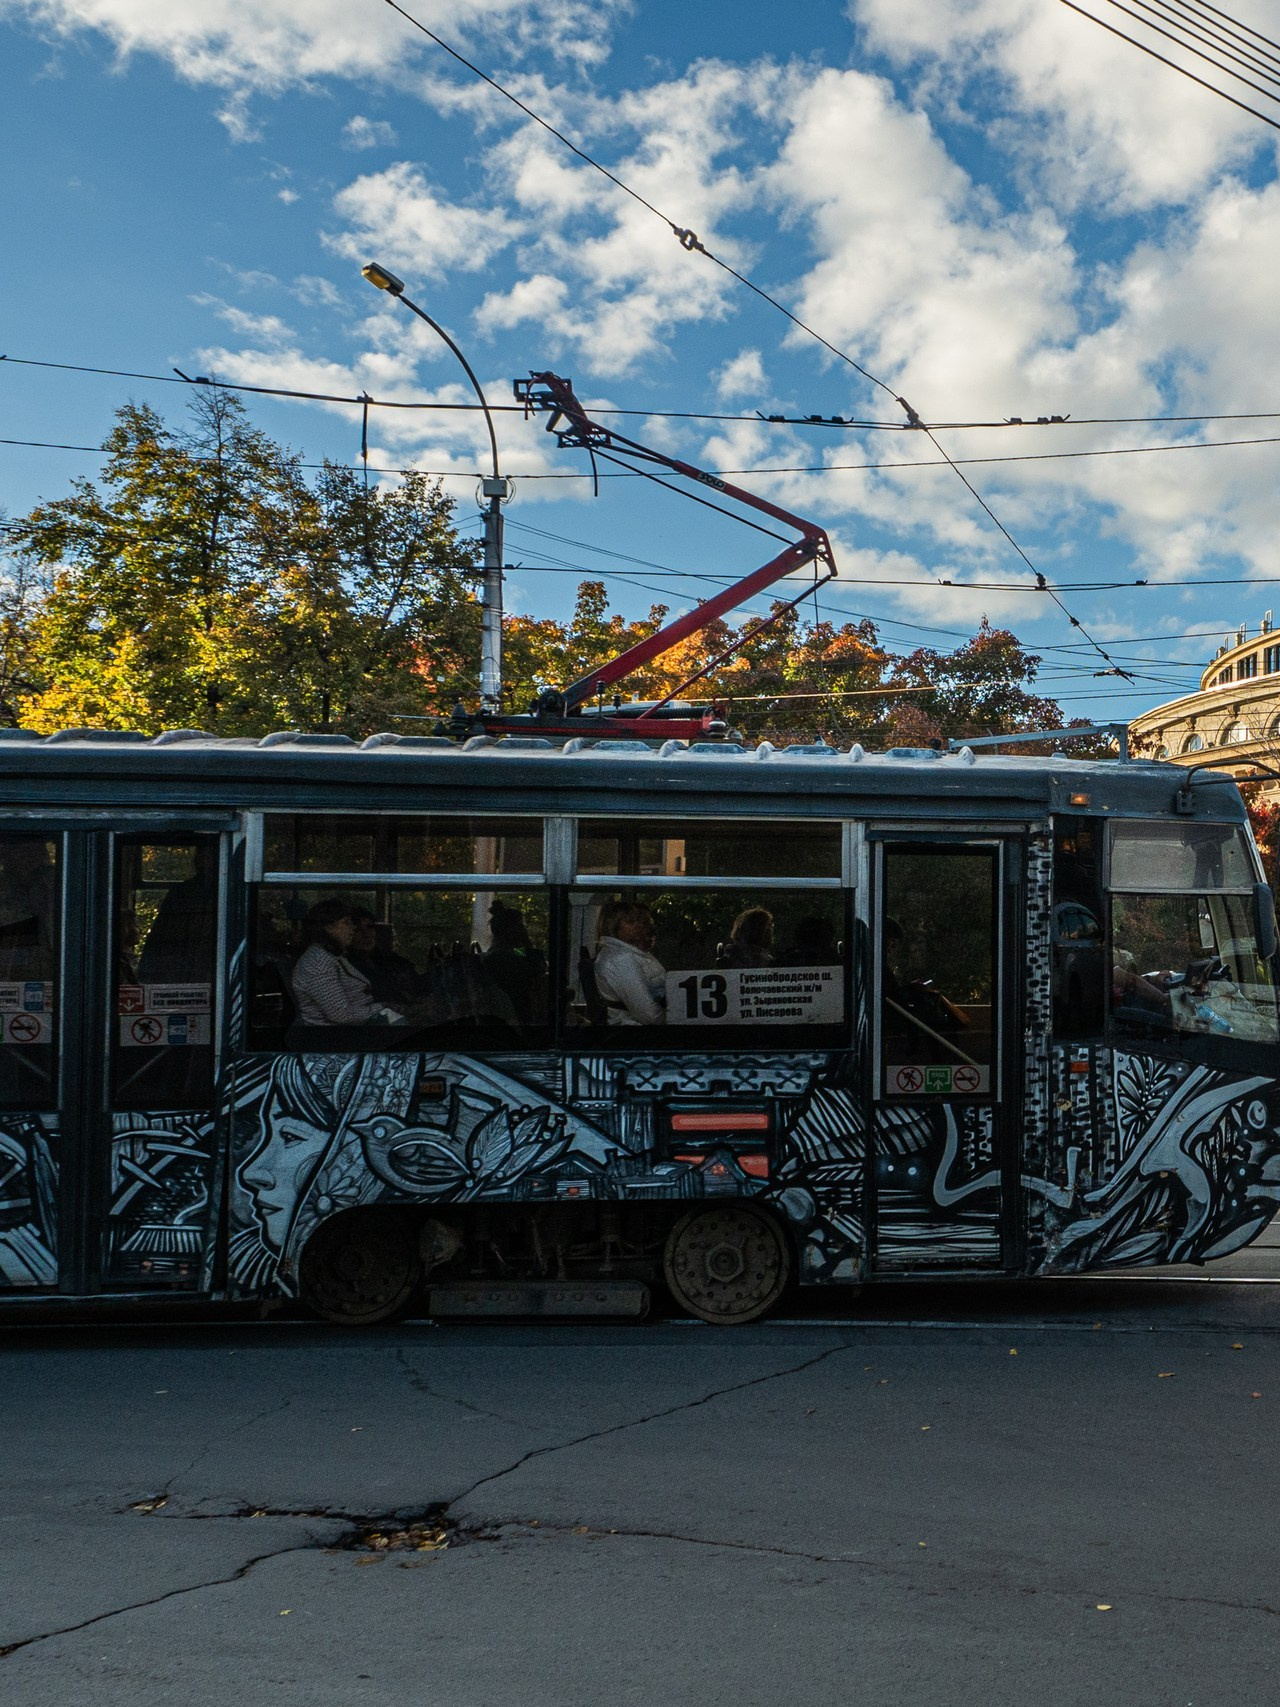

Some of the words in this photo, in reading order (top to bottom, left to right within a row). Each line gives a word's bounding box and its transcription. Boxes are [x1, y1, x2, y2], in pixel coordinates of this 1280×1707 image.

[740, 972, 820, 984] Гусинобродское
[821, 972, 833, 981] ш.
[740, 983, 802, 994] Волочаевский
[803, 983, 822, 992] ж/м
[678, 974, 728, 1019] 13
[740, 998, 752, 1006] ул.
[753, 995, 813, 1005] Зыряновская
[740, 1009, 754, 1018] ул.
[756, 1007, 803, 1017] Писарева
